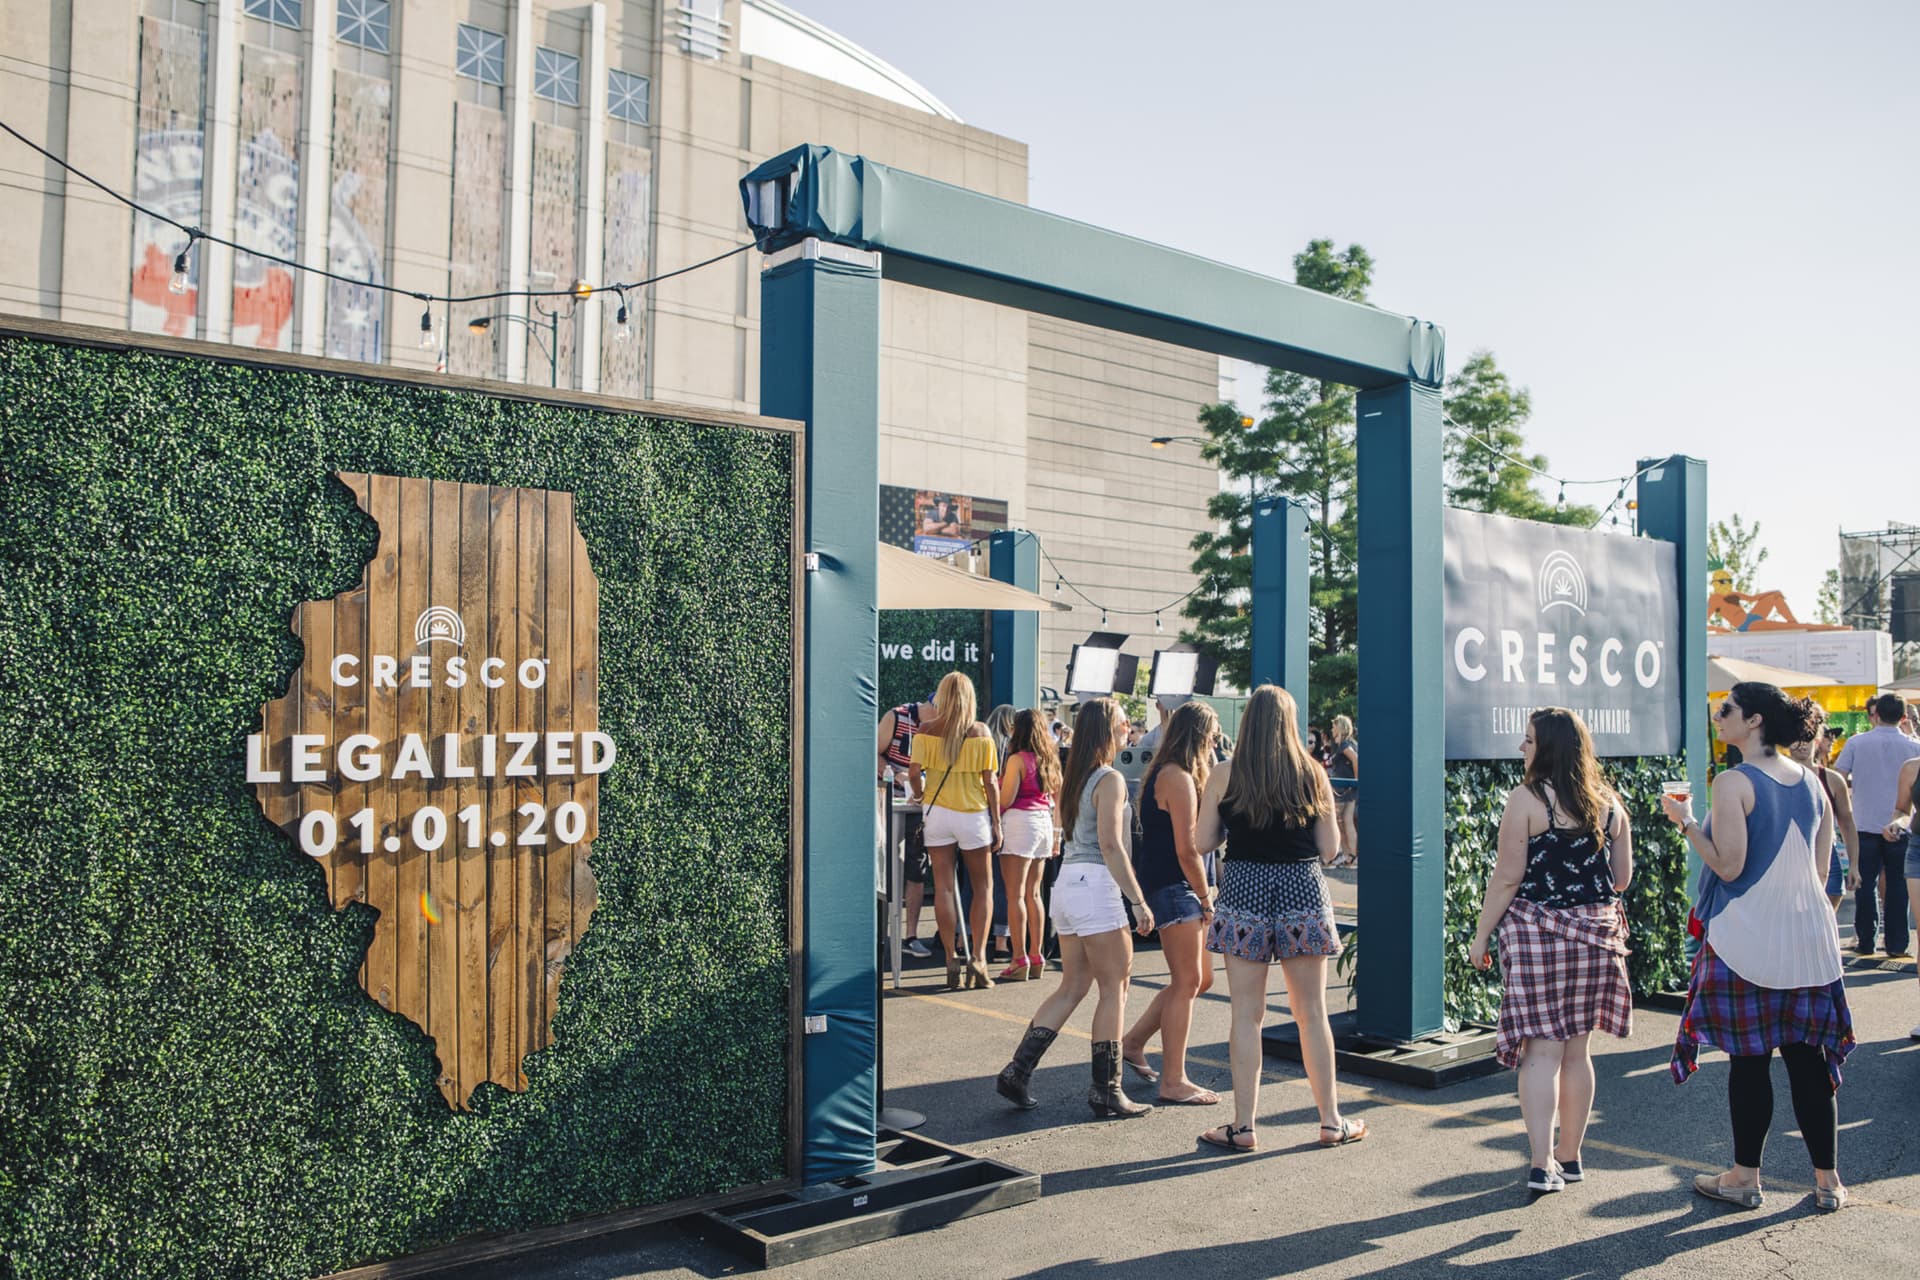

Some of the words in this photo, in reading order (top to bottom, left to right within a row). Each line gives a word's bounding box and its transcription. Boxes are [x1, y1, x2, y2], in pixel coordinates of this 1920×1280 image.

[330, 653, 546, 690] CRESCO
[880, 643, 914, 660] we
[921, 639, 955, 662] did
[1454, 626, 1662, 689] CRESCO
[1492, 706, 1536, 734] ELEVAT
[1587, 707, 1631, 734] CANNABIS
[246, 731, 617, 784] LEGALIZED
[300, 801, 587, 858] 01.01.20
